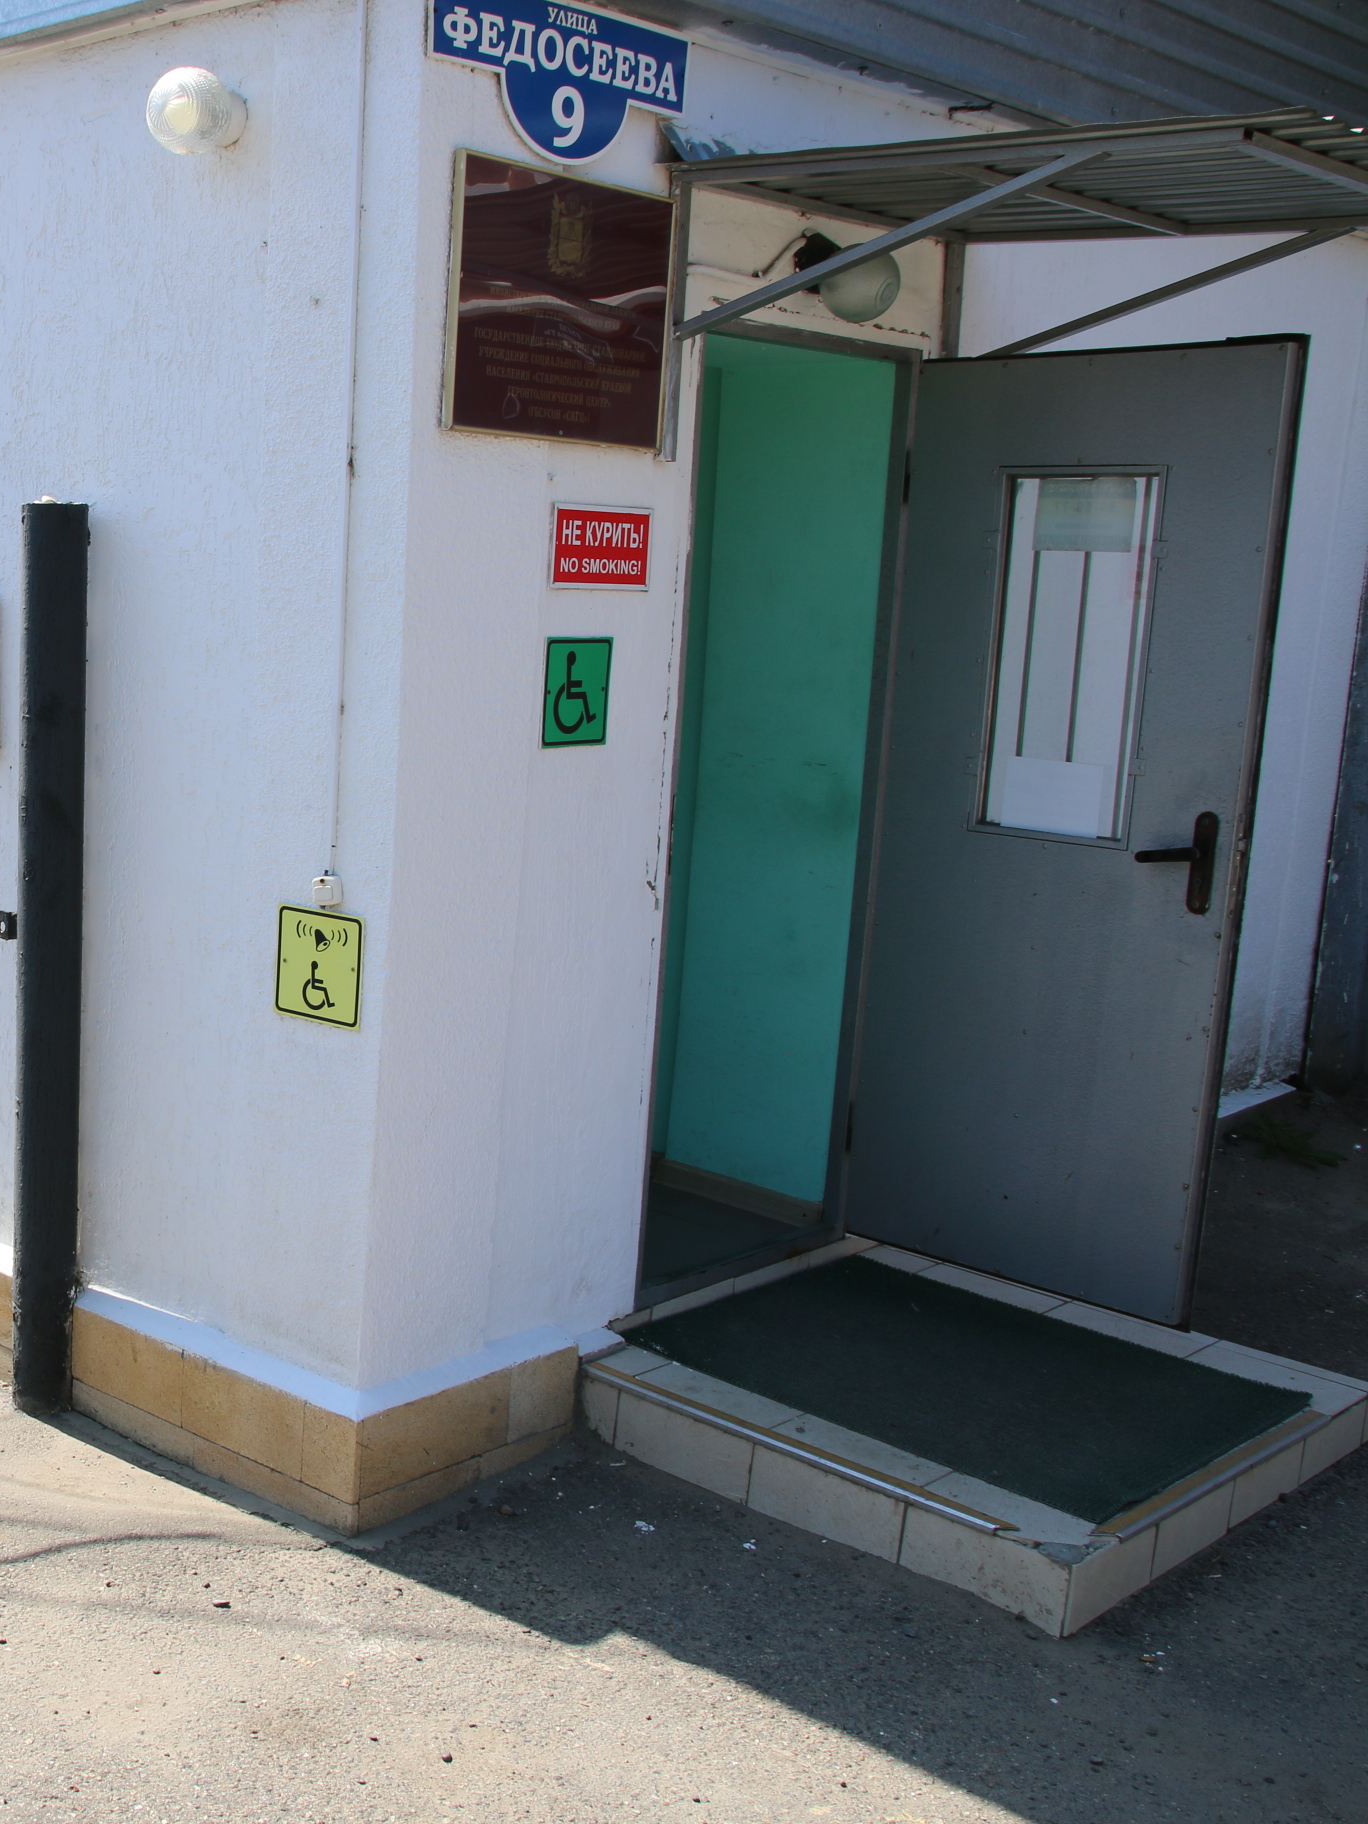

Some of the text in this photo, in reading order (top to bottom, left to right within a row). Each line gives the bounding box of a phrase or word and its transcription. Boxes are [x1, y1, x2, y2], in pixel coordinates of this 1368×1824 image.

[548, 7, 598, 35] УЛИЦА
[443, 6, 678, 102] ФЕДОСЕЕВА
[551, 85, 585, 148] 9
[478, 346, 529, 363] УЧРЕЖДЕНИЕ
[530, 354, 582, 370] СОЦИАЛЬНОГО
[486, 365, 530, 381] НАСЕЛЕНИЯ
[601, 380, 632, 395] КРАЕВОЙ
[507, 385, 584, 405] ГЕРОНТОЛОГИЧЕСКИЙ
[562, 519, 644, 549] НЕ КУРИТЬ!
[560, 557, 642, 575] NO SMOKING!
